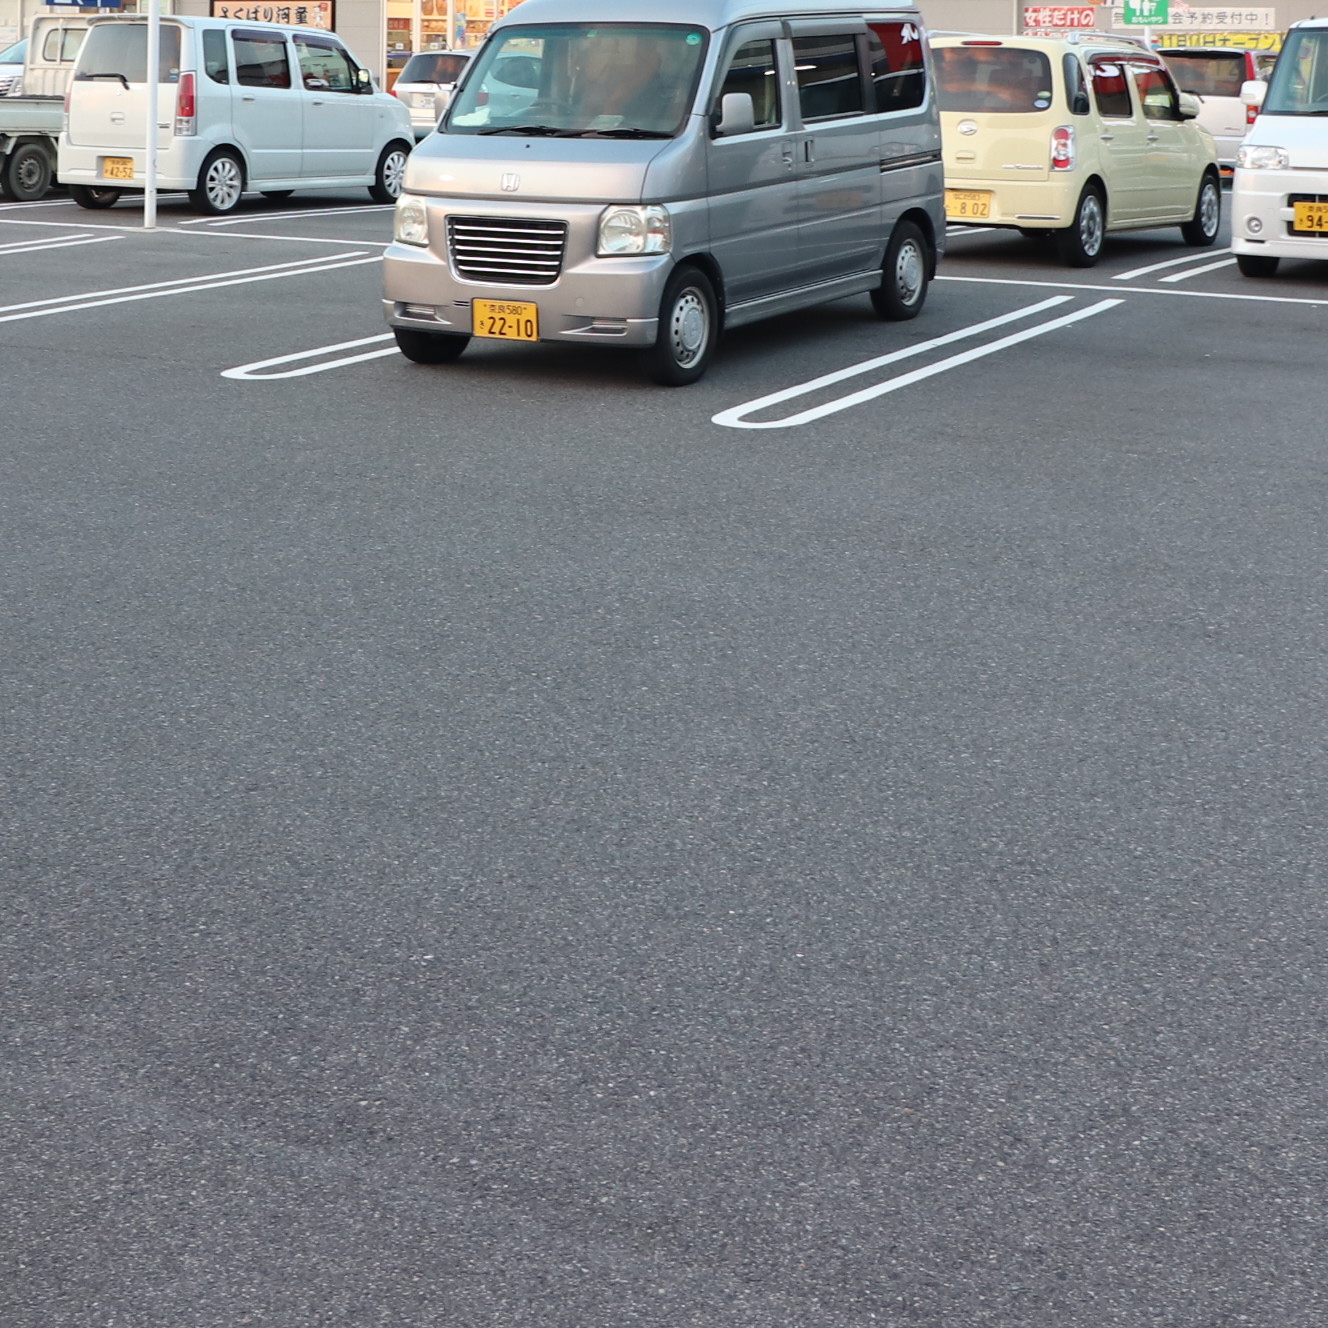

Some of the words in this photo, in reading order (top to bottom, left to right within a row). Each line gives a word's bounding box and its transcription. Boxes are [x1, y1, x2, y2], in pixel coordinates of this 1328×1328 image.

[1024, 7, 1093, 26] 女性だけの
[488, 316, 534, 338] 22-10
